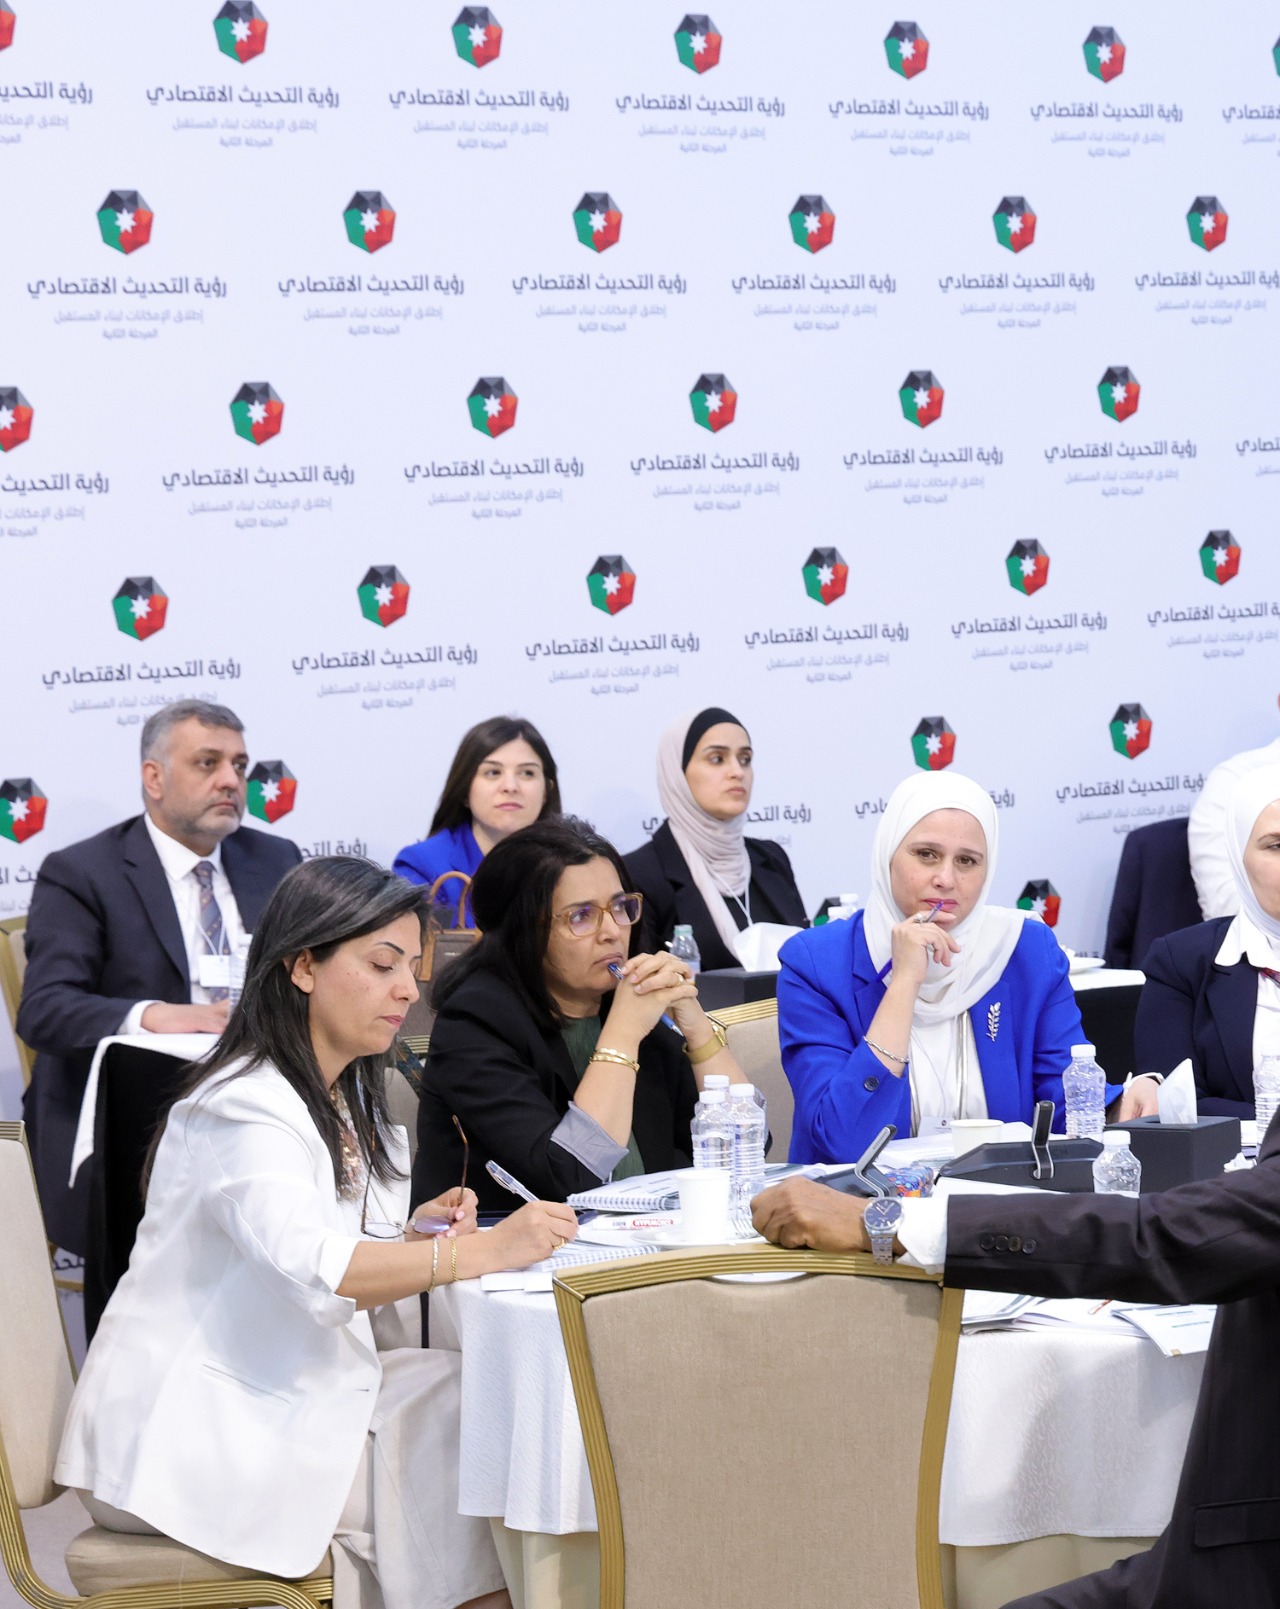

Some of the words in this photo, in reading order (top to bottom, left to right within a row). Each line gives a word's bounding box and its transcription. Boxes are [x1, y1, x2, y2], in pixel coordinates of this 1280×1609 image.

[0, 80, 53, 103] التحدي
[59, 81, 93, 105] رؤية
[145, 84, 233, 106] الاقتصادي
[238, 85, 303, 107] التحديث
[307, 86, 339, 108] رؤية
[389, 87, 470, 109] الاقتصادي
[474, 89, 535, 110] التحديث
[539, 90, 569, 112] رؤية
[615, 93, 691, 113] الاقتصادي
[695, 95, 753, 115] التحديث
[756, 96, 785, 117] رؤية
[828, 98, 900, 118] الاقتصادي
[904, 99, 959, 119] التحديث
[962, 100, 989, 121] رؤية
[1030, 101, 1098, 121] الاقتصادي
[1102, 102, 1154, 122] التحديث
[1157, 103, 1183, 123] رؤية
[26, 276, 117, 299] الاقتصادي
[121, 276, 189, 298] التحديث
[193, 275, 227, 298] رؤية
[278, 274, 362, 297] الاقتصادي
[366, 274, 429, 296] التحديث
[433, 273, 464, 296] رؤية
[512, 273, 590, 295] الاقتصادي
[595, 273, 654, 294] التحديث
[657, 273, 686, 294] رؤية
[731, 273, 805, 294] الاقتصادي
[809, 273, 865, 294] التحديث
[868, 273, 896, 293] رؤية
[938, 272, 1009, 293] الاقتصادي
[1012, 272, 1065, 292] التحديث
[1068, 272, 1095, 291] رؤية
[1134, 270, 1201, 291] الاقتصادي
[1205, 270, 1255, 290] التحديث
[843, 447, 915, 470] الاقتصادي
[918, 446, 973, 467] التحديث
[976, 445, 1003, 466] رؤية
[1044, 441, 1112, 464] الاقتصادي
[1116, 440, 1168, 460] التحديث
[1170, 439, 1197, 459] رؤية
[403, 459, 484, 483] الاقتصادي
[489, 457, 550, 480] التحديث
[553, 456, 584, 477] رؤية
[630, 453, 706, 475] الاقتصادي
[710, 451, 767, 473] التحديث
[771, 451, 800, 472] رؤية
[1, 473, 70, 496] التحديث
[75, 471, 110, 494] رؤية
[162, 467, 248, 492] الاقتصادي
[253, 465, 318, 488] التحديث
[322, 463, 355, 486] رؤية
[1024, 612, 1078, 634] التحديث
[1081, 611, 1107, 631] رؤية
[1147, 604, 1214, 627] الاقتصادي
[1217, 601, 1268, 623] التحديث
[744, 626, 818, 649] الاقتصادي
[822, 623, 878, 645] التحديث
[881, 621, 909, 642] رؤية
[951, 615, 1021, 639] الاقتصادي
[525, 636, 603, 661] الاقتصادي
[608, 633, 667, 656] التحديث
[670, 631, 699, 653] رؤية
[291, 649, 375, 675] الاقتصادي
[380, 645, 443, 669] التحديث
[446, 643, 477, 665] رؤية
[41, 663, 131, 690] الاقتصادي
[136, 659, 203, 683] التحديث
[208, 657, 241, 680] رؤية
[1055, 779, 1124, 803] الاقتصادي
[1127, 774, 1180, 797] التحديث
[1183, 772, 1207, 791] ؤية
[746, 805, 779, 823] التحد
[783, 803, 811, 824] رؤية
